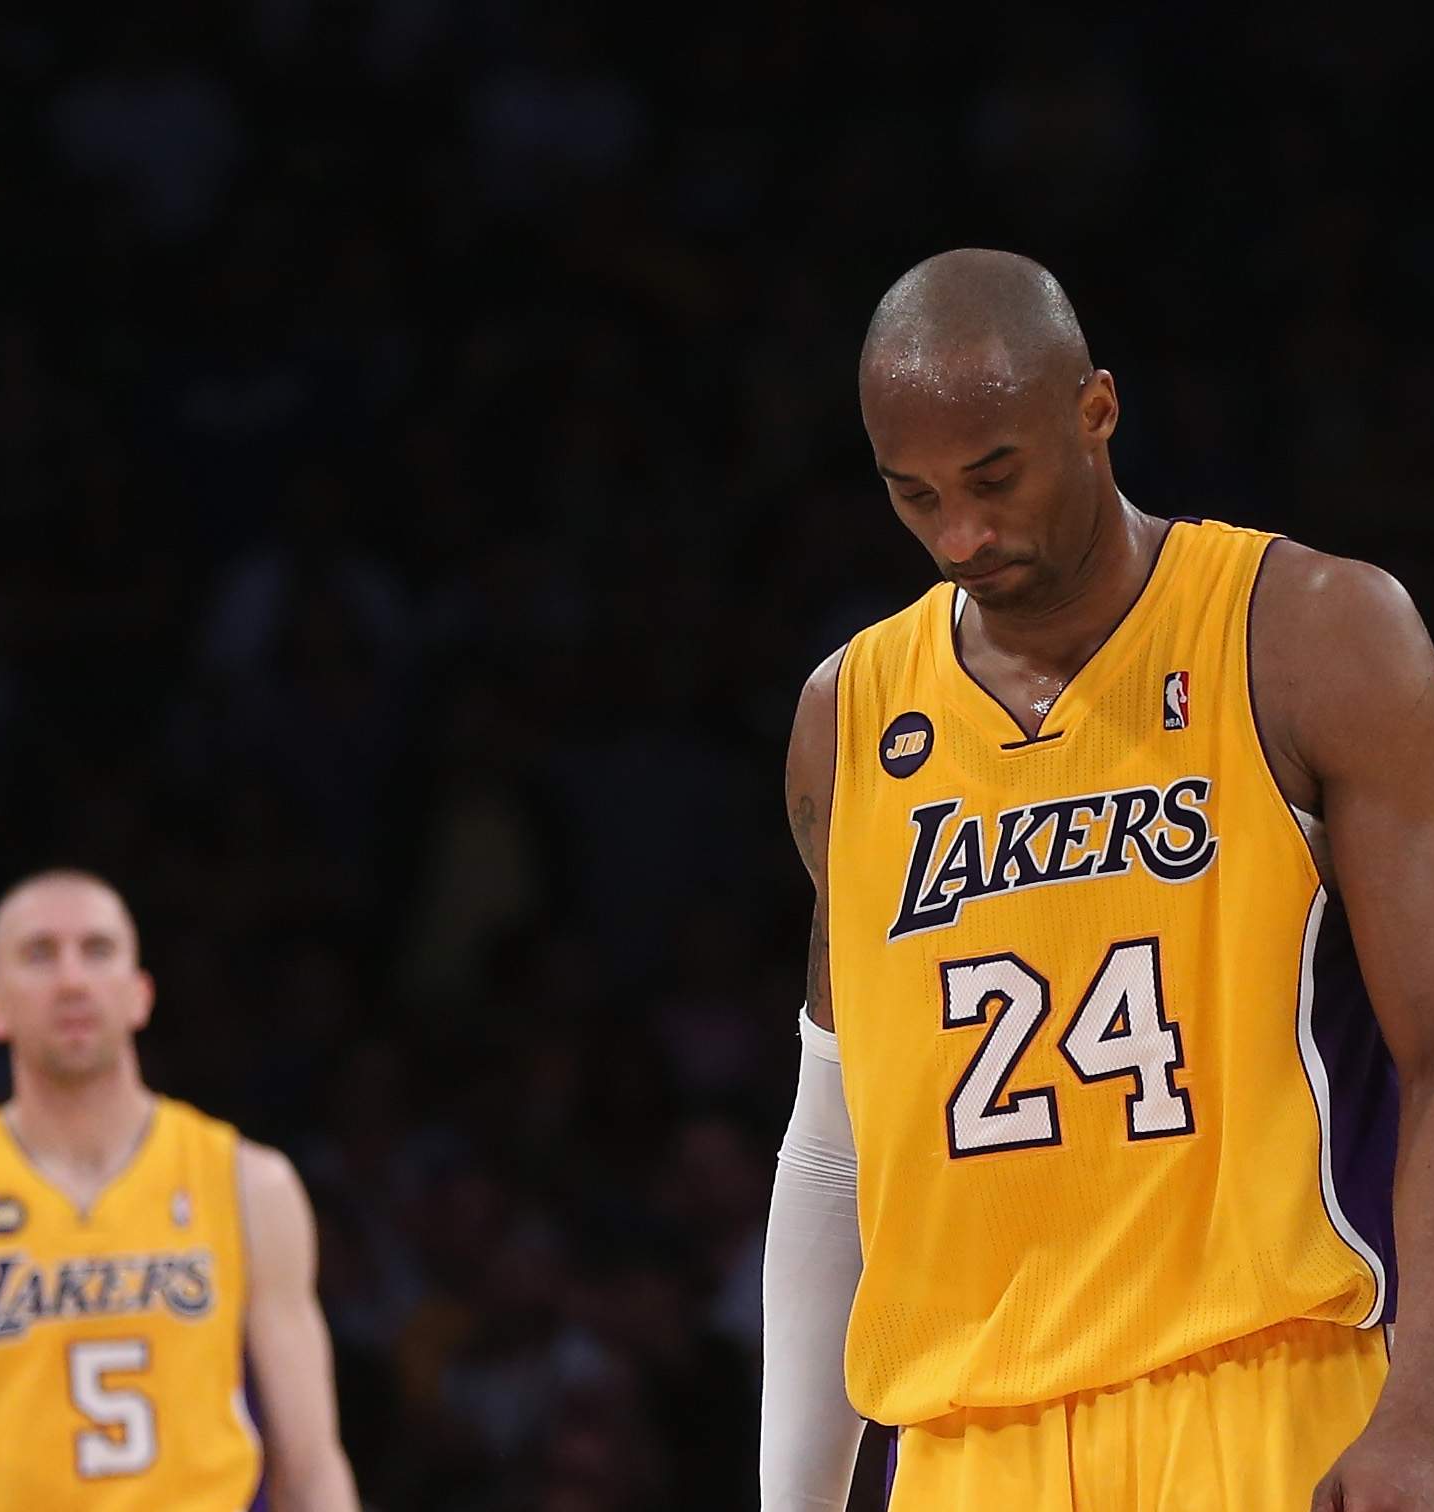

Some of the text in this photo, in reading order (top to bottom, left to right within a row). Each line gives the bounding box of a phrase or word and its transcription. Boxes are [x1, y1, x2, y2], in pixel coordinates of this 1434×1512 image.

[886, 730, 927, 760] JB
[886, 776, 1220, 943] LAKERS
[939, 936, 1196, 1160] 24
[69, 1339, 156, 1480] 5
